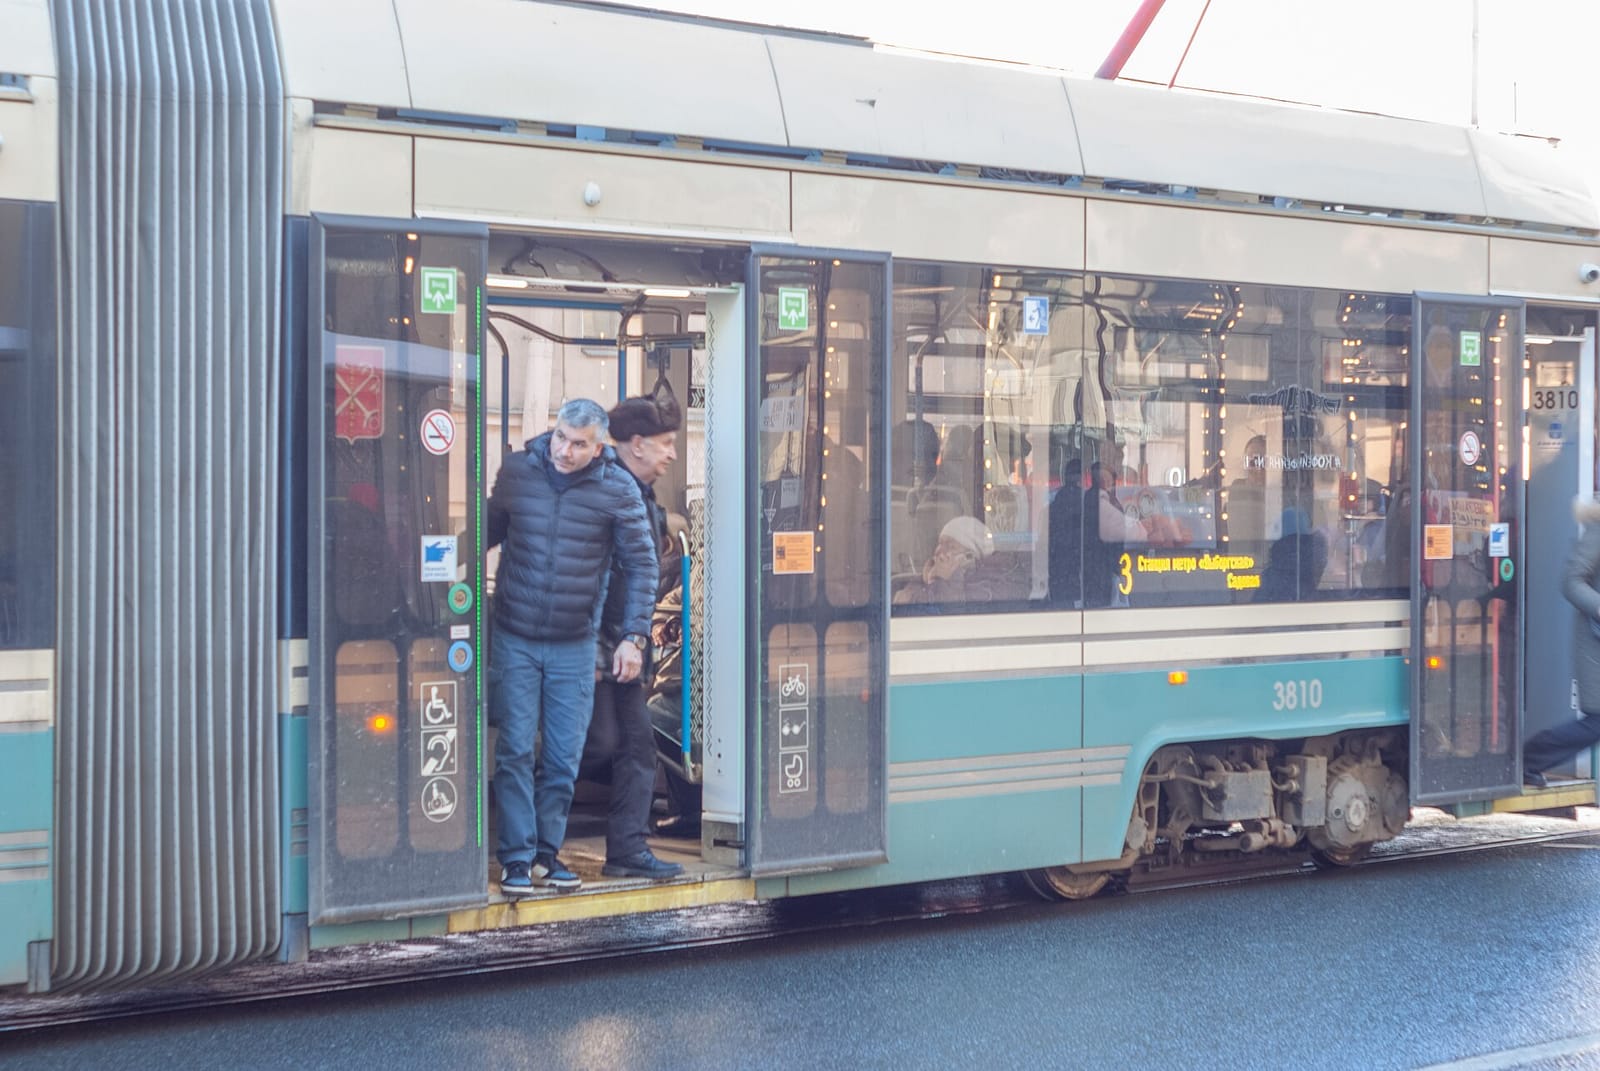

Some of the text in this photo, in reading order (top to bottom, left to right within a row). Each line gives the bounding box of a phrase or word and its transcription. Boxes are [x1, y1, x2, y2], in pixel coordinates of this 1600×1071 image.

[1534, 390, 1578, 410] 3810
[1119, 553, 1133, 595] 3
[1272, 679, 1322, 711] 3810
